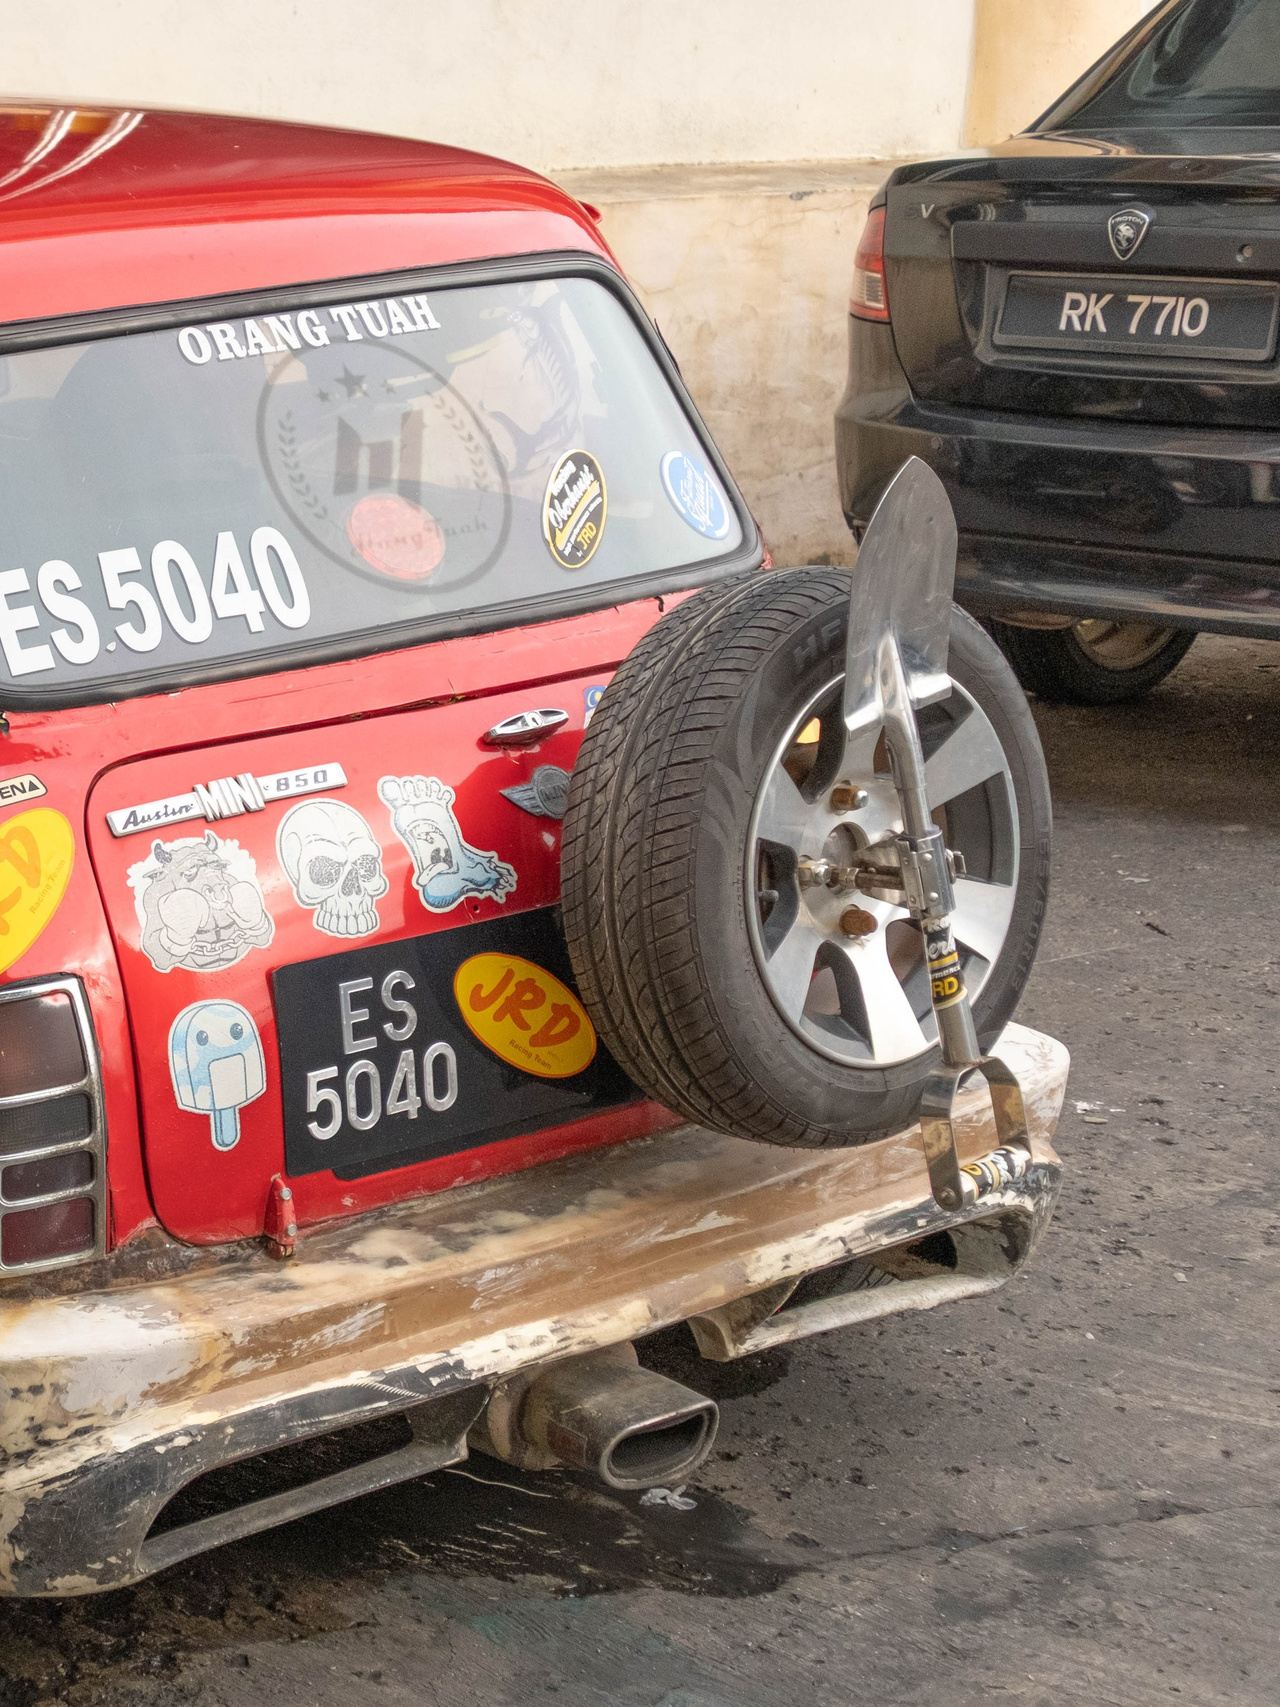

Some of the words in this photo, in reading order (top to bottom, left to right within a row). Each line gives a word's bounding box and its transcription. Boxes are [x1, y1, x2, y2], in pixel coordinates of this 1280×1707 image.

[1111, 216, 1144, 225] PROTON
[178, 310, 330, 365] ORANG
[329, 295, 441, 342] TUAH
[1059, 291, 1114, 332] RK
[1127, 295, 1209, 337] 7710
[576, 521, 597, 550] JRD
[122, 803, 193, 831] Austin
[193, 772, 266, 822] MINI
[276, 769, 328, 793] 850
[29, 882, 54, 915] Racing
[469, 968, 581, 1048] JRD
[932, 976, 959, 998] RD
[339, 970, 418, 1055] ES
[509, 1039, 533, 1059] Racing
[534, 1054, 552, 1070] Team
[306, 1041, 459, 1141] 5040
